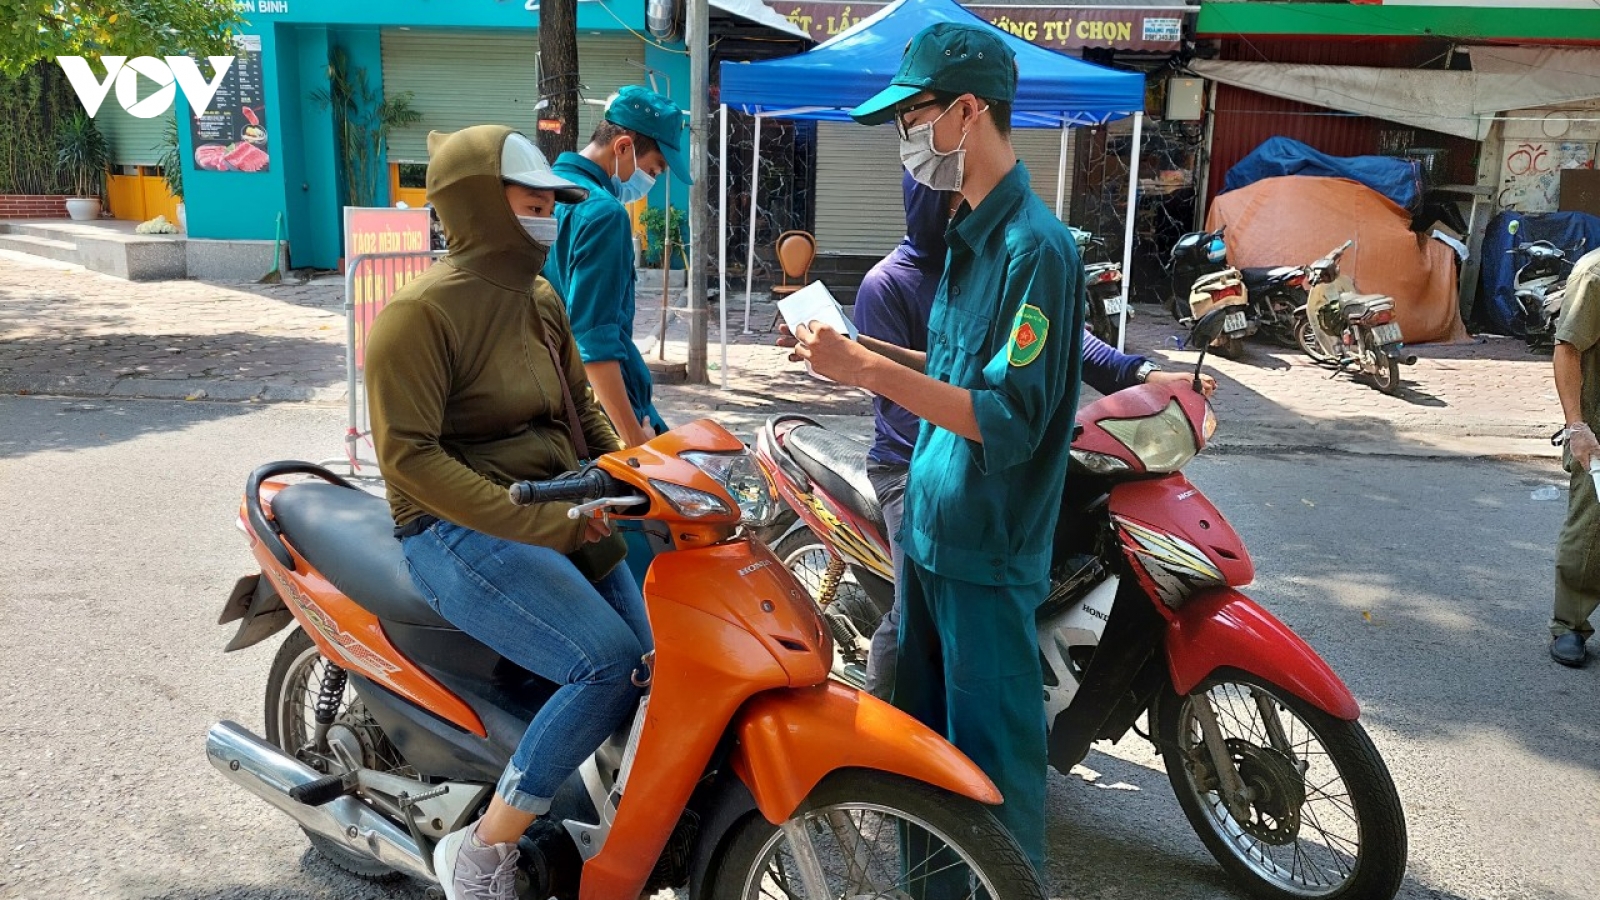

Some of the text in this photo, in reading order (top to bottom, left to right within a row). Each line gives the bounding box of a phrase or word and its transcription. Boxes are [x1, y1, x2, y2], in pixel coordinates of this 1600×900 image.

[826, 6, 872, 35] LẨ
[1043, 18, 1072, 46] TỰ
[1076, 20, 1132, 46] CHỌN
[1082, 603, 1109, 622] HOND
